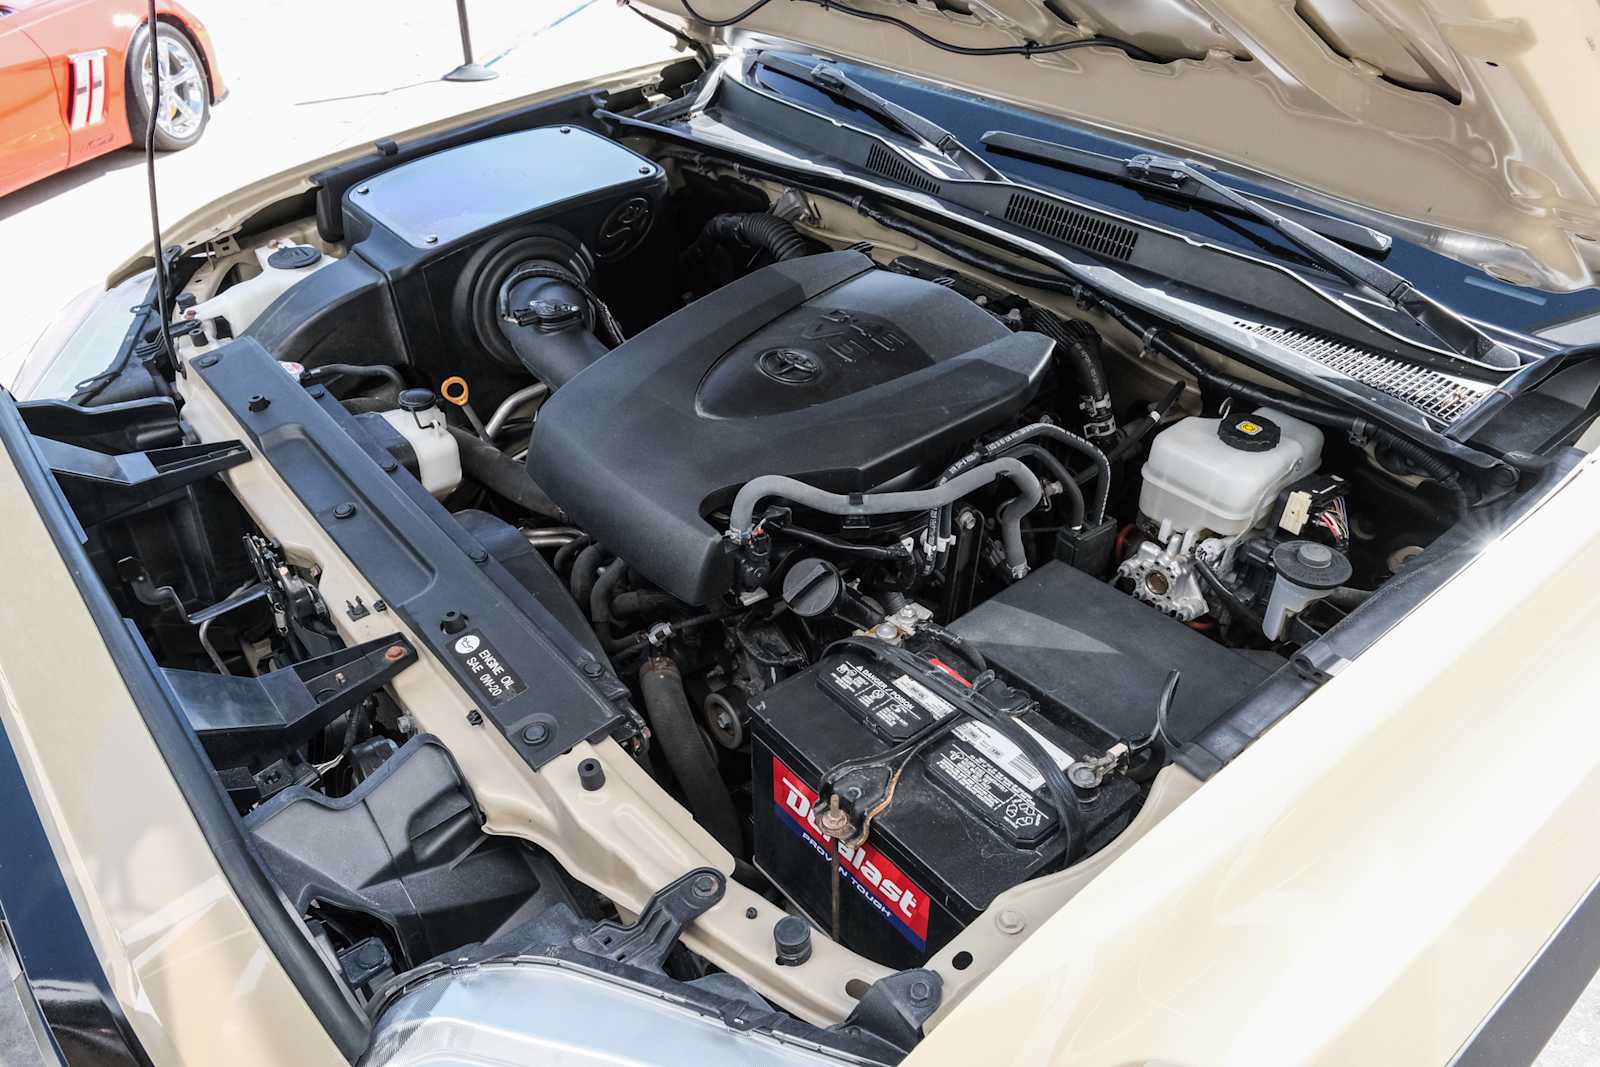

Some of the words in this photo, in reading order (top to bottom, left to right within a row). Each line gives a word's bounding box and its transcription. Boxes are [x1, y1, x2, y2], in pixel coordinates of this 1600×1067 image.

[467, 657, 484, 673] SAE
[480, 674, 502, 696] 0W-20
[479, 649, 504, 676] ENGINE
[501, 676, 514, 690] OIL
[862, 669, 888, 690] DANGER
[889, 691, 915, 710] POISON
[802, 831, 848, 878] PROVN
[850, 877, 893, 918] TOUGH
